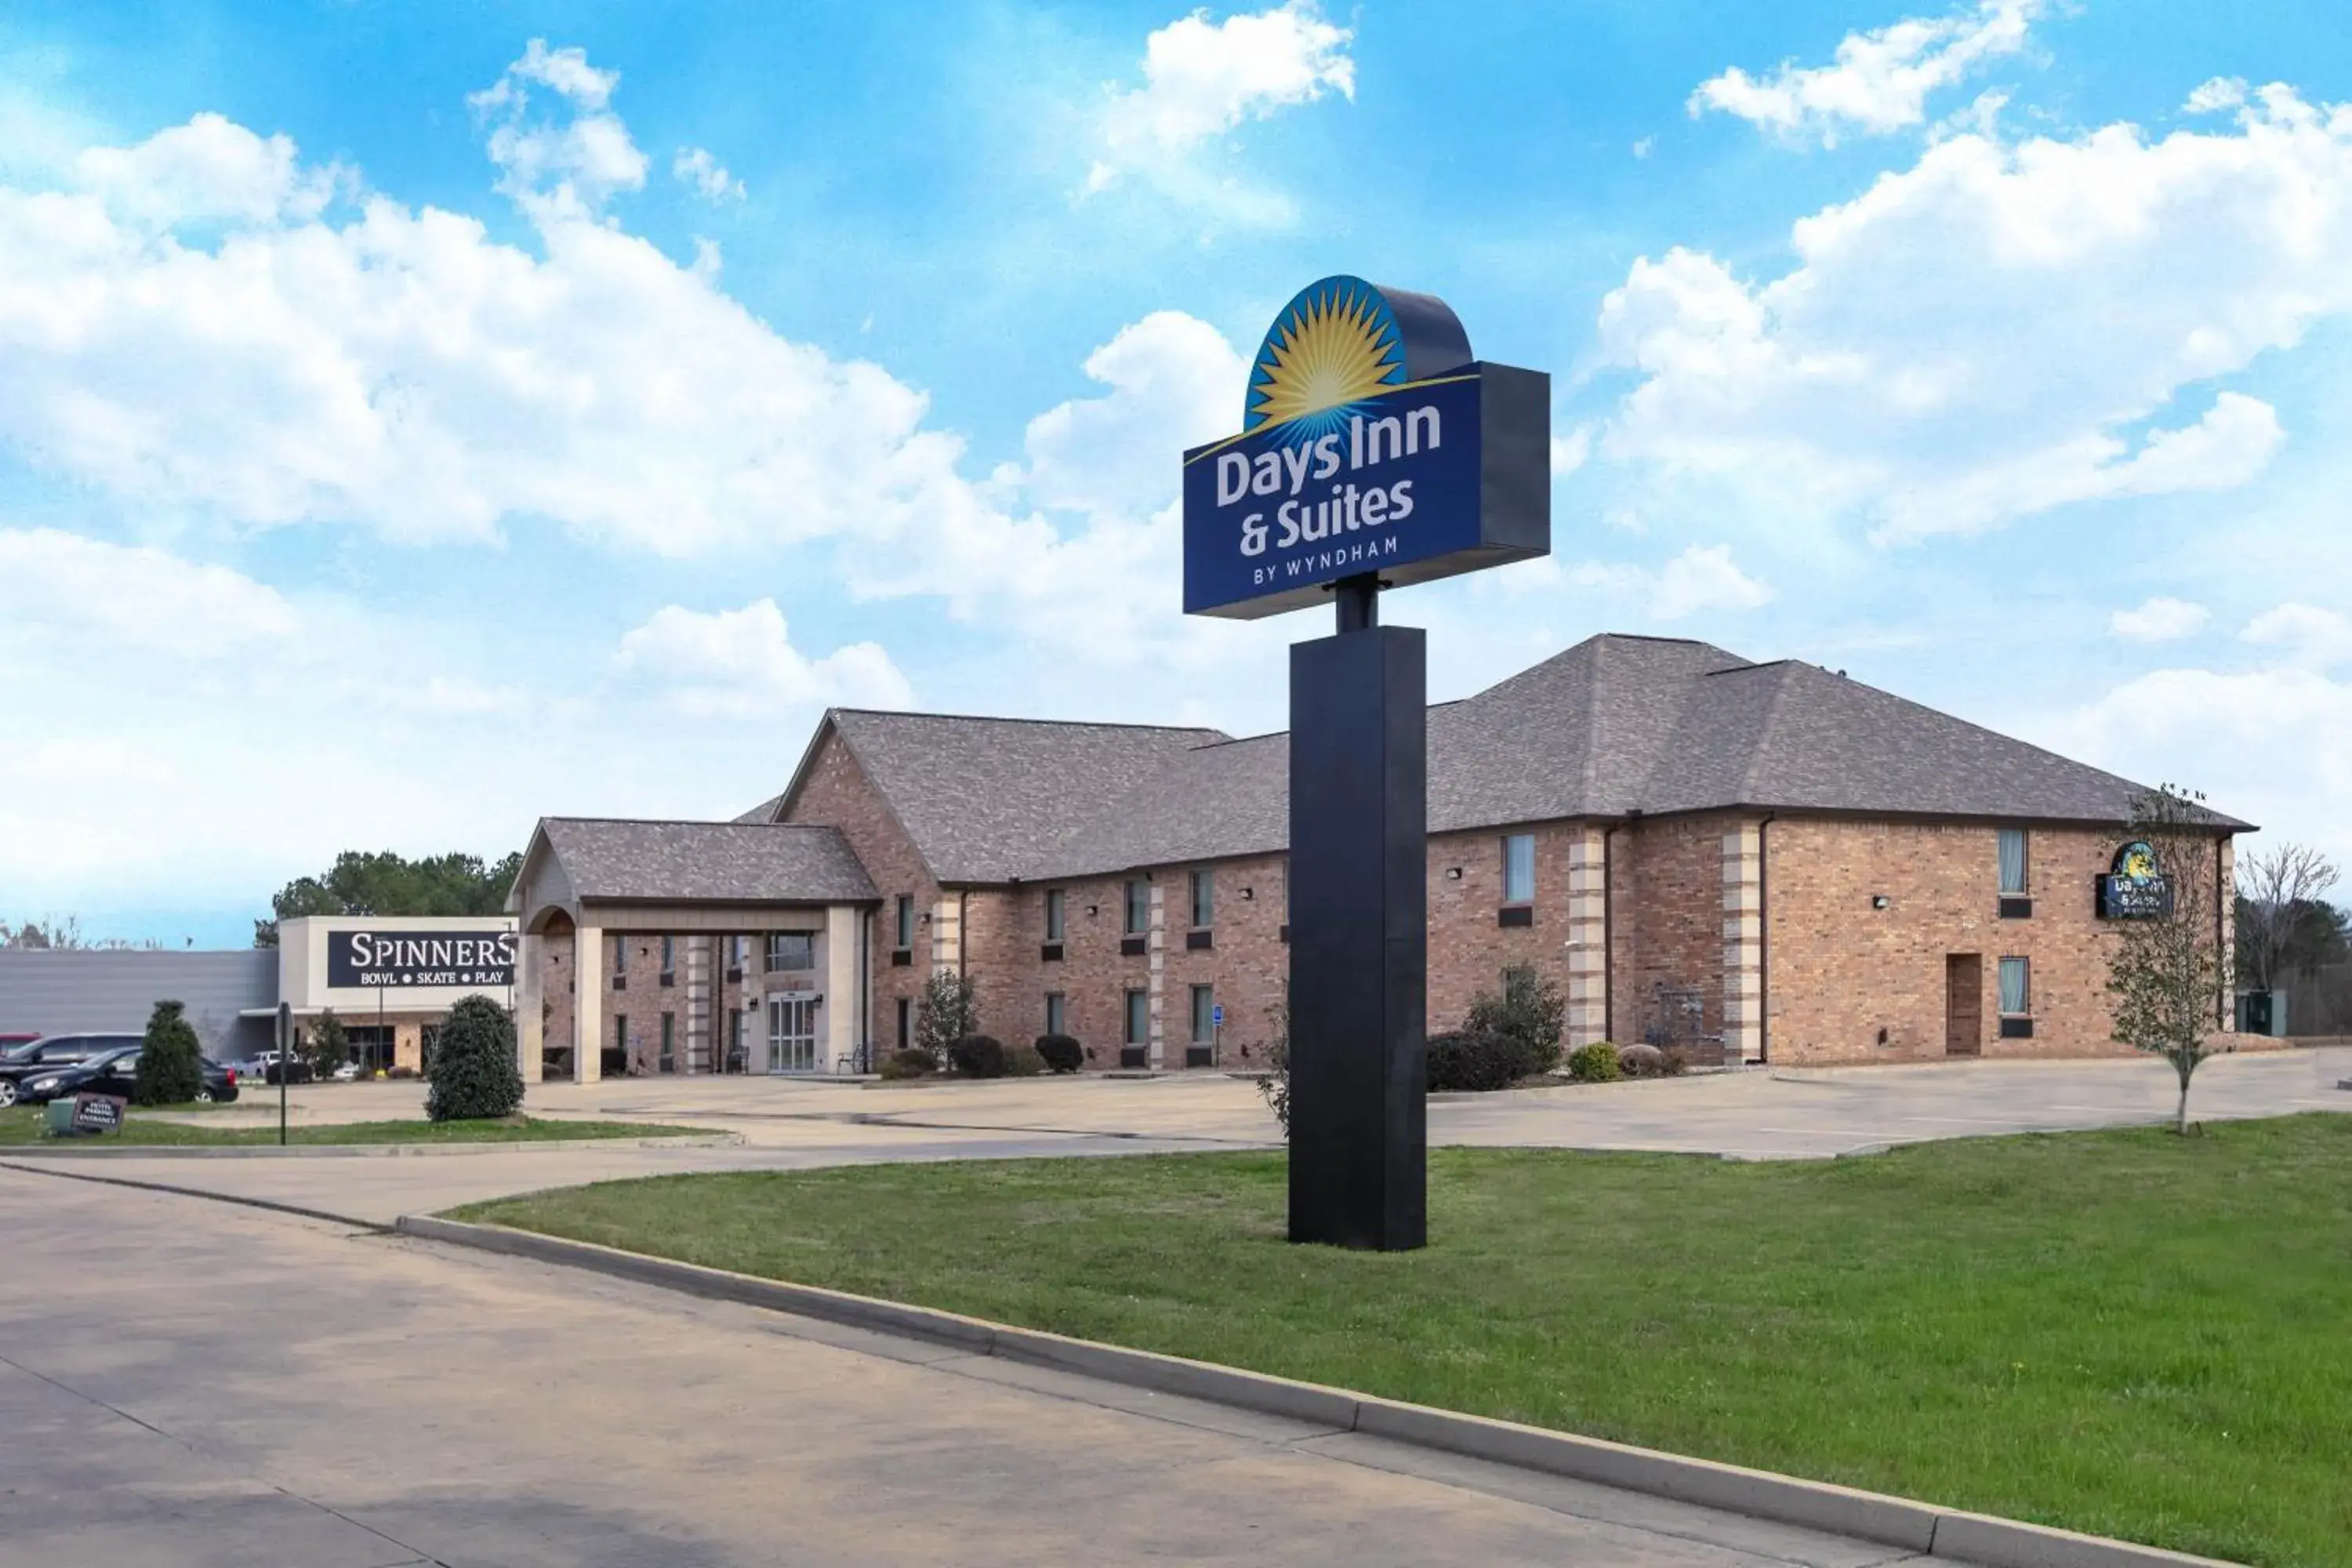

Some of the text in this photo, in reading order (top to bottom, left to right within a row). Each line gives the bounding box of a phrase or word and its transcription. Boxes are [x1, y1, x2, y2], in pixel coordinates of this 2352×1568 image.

[1218, 405, 1441, 507] Days Inn
[1240, 480, 1414, 556] & Suites
[1254, 535, 1397, 585] BY WYNDHAM
[350, 933, 515, 967] SPINNERS
[361, 971, 504, 985] BOWL SKATE PLAY
